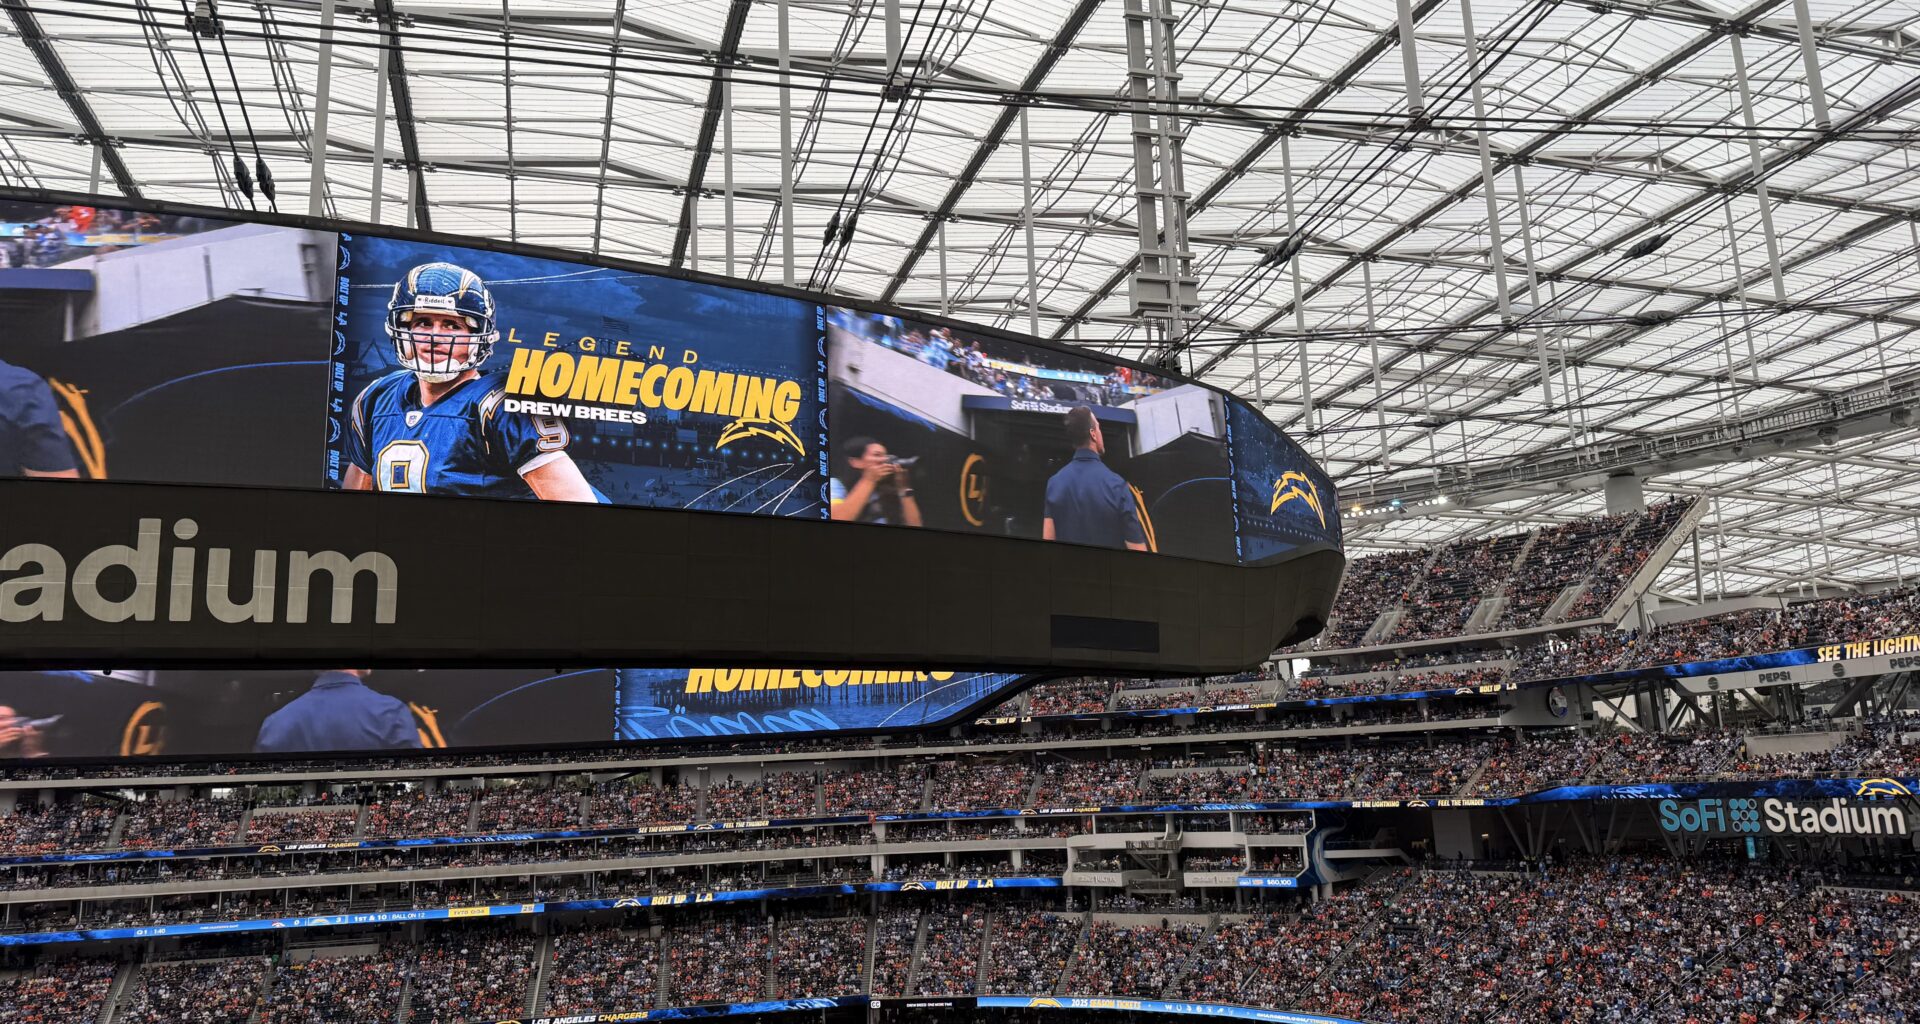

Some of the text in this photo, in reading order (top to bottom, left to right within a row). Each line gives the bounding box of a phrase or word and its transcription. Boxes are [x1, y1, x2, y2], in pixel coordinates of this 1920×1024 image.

[340, 277, 349, 306] BOLT UP
[508, 328, 698, 364] LEGEND
[335, 362, 345, 392] BOLT UP
[504, 348, 801, 423] HOMECOMING
[504, 398, 648, 424] DREW BREES
[1011, 400, 1030, 410] SoFi
[329, 450, 340, 480] BOLT UP
[0, 518, 398, 624] adium
[1818, 646, 1840, 662] SEE
[1844, 640, 1870, 659] THE
[685, 668, 955, 693] HOMEC
[1494, 684, 1501, 692] UP
[1758, 671, 1791, 684] PEPSI
[1372, 800, 1400, 808] LIGHTNING
[1659, 798, 1906, 835] SoFi Stadium
[936, 880, 955, 890] BOLT
[956, 880, 968, 889] UP
[651, 895, 673, 906] BOLT
[674, 894, 687, 904] UP
[1072, 999, 1141, 1009] 2025 SEASON TICKETS
[553, 1015, 596, 1024] ANGELES
[598, 1012, 648, 1022] CHARGERS
